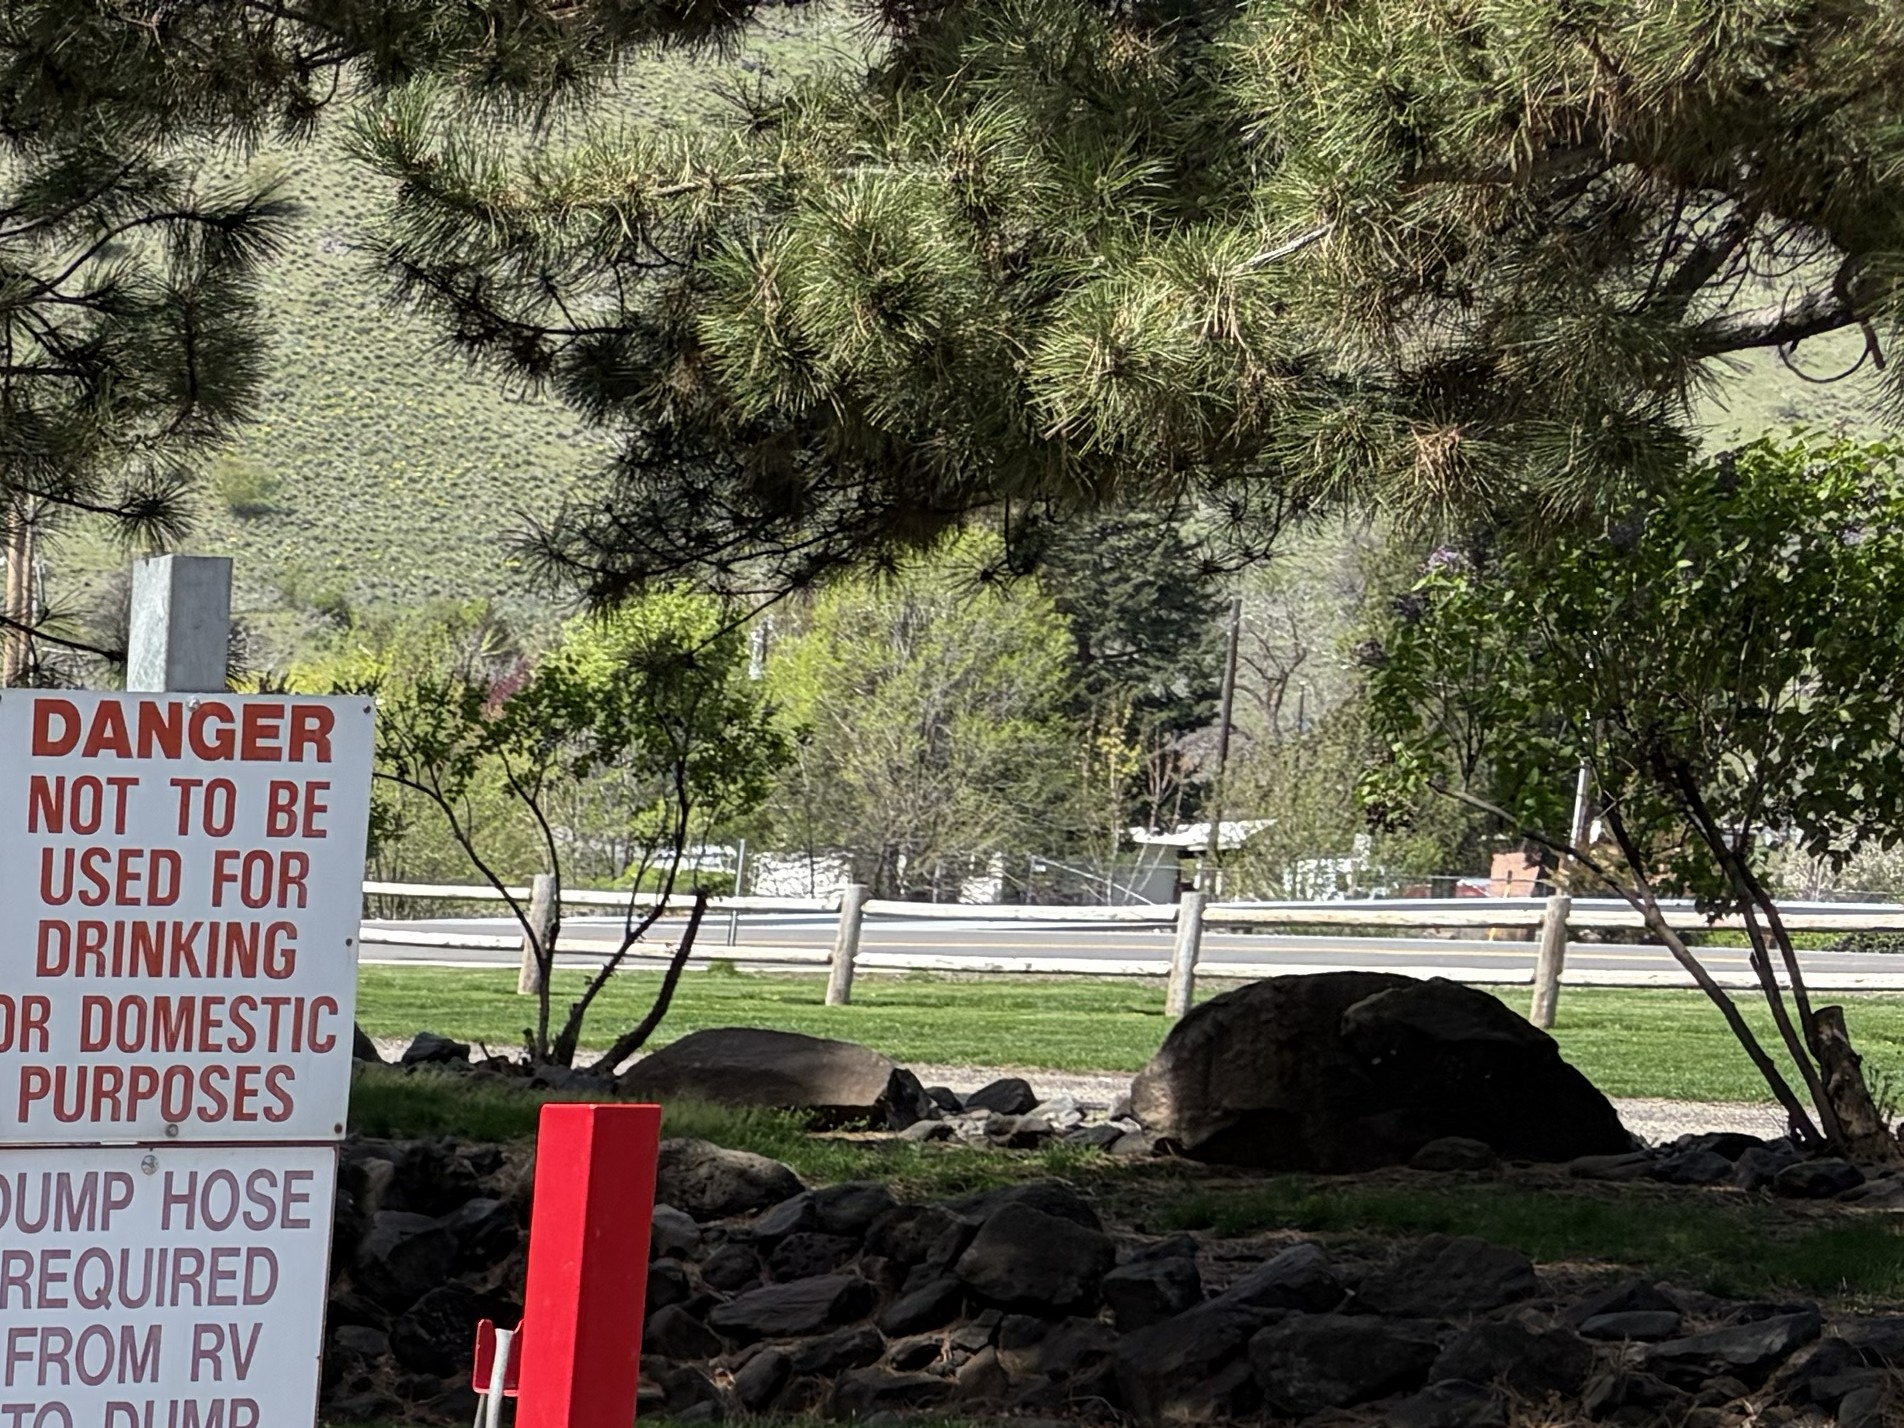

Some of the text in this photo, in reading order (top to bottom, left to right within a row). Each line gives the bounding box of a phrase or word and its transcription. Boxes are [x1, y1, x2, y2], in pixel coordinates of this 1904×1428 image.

[32, 698, 334, 762] DANGER
[29, 775, 329, 837] NOT TO BE
[41, 847, 308, 907] USED FOR
[38, 919, 296, 978] DRINKING
[81, 995, 337, 1052] DOMESTIC
[18, 1064, 293, 1121] PURPOSES
[161, 1169, 314, 1232] HOSE
[5, 1322, 263, 1387] FROM RV
